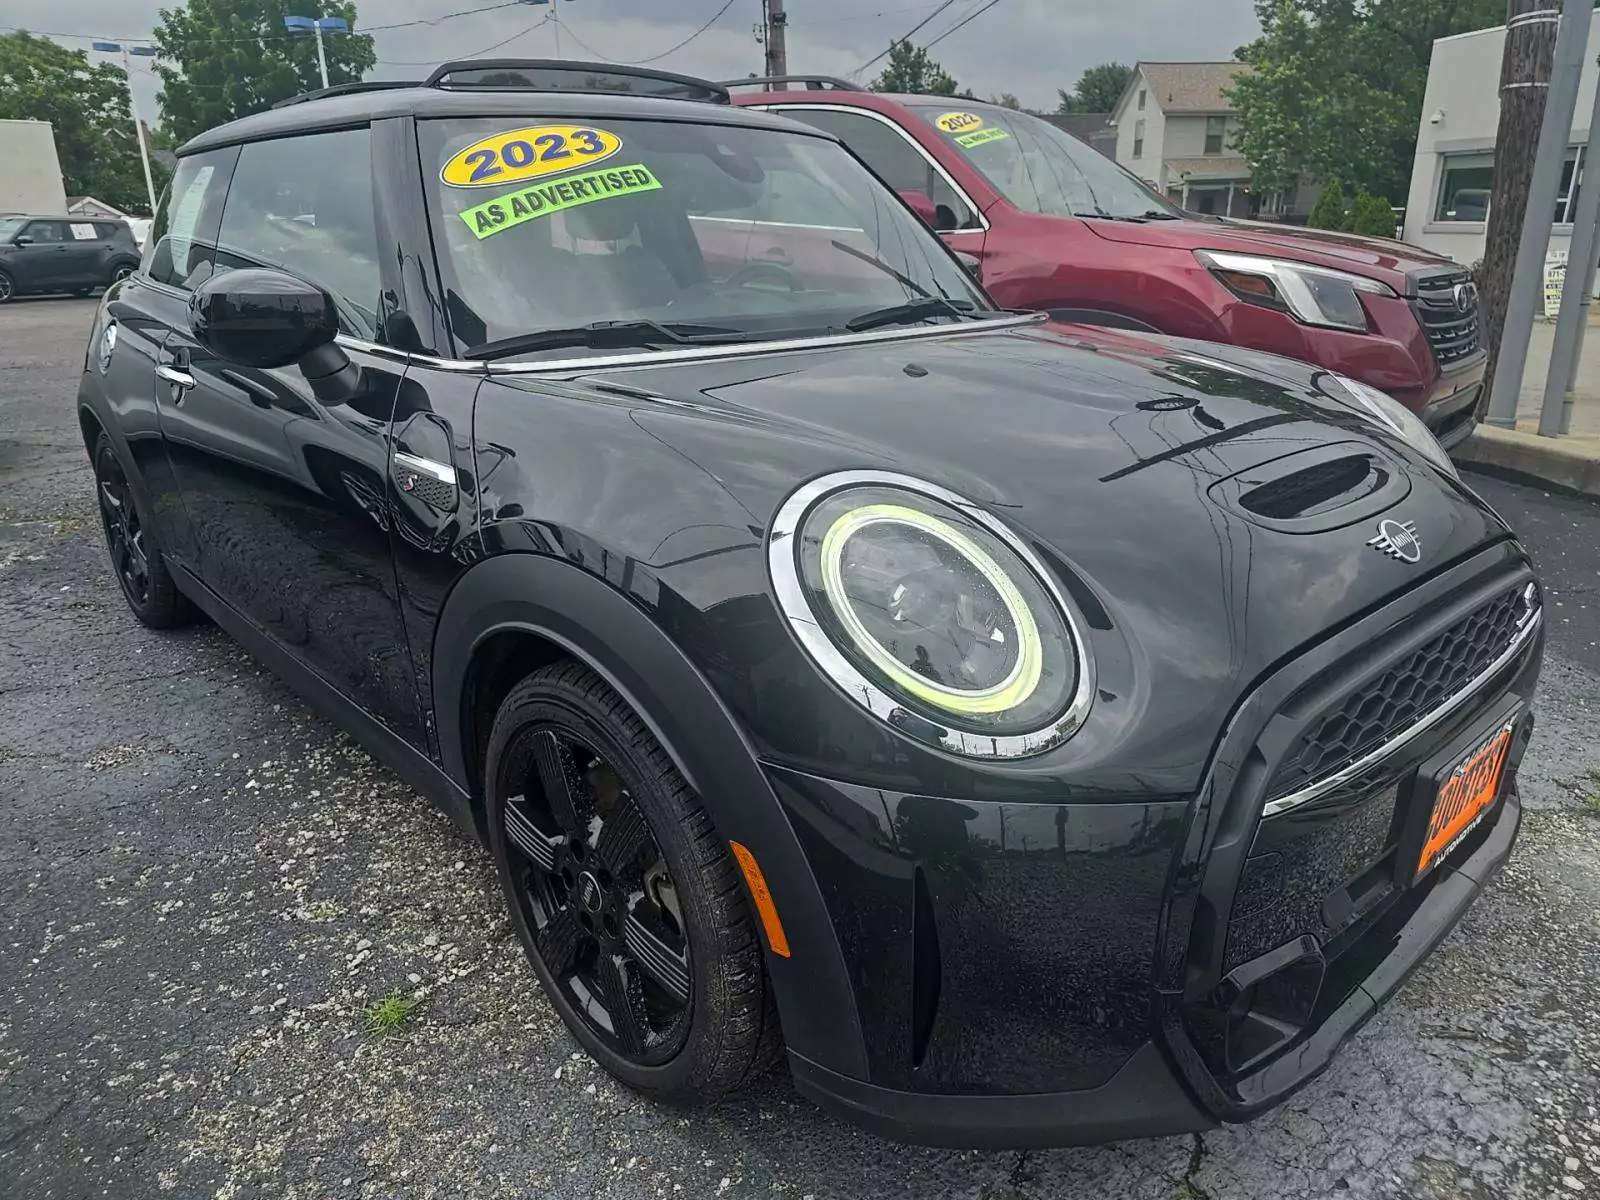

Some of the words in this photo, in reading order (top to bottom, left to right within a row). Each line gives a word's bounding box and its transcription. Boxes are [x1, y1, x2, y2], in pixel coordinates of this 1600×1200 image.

[941, 113, 980, 131] 2022
[465, 129, 607, 183] 2023
[475, 203, 507, 233] AS
[511, 168, 651, 218] ADVERTISED
